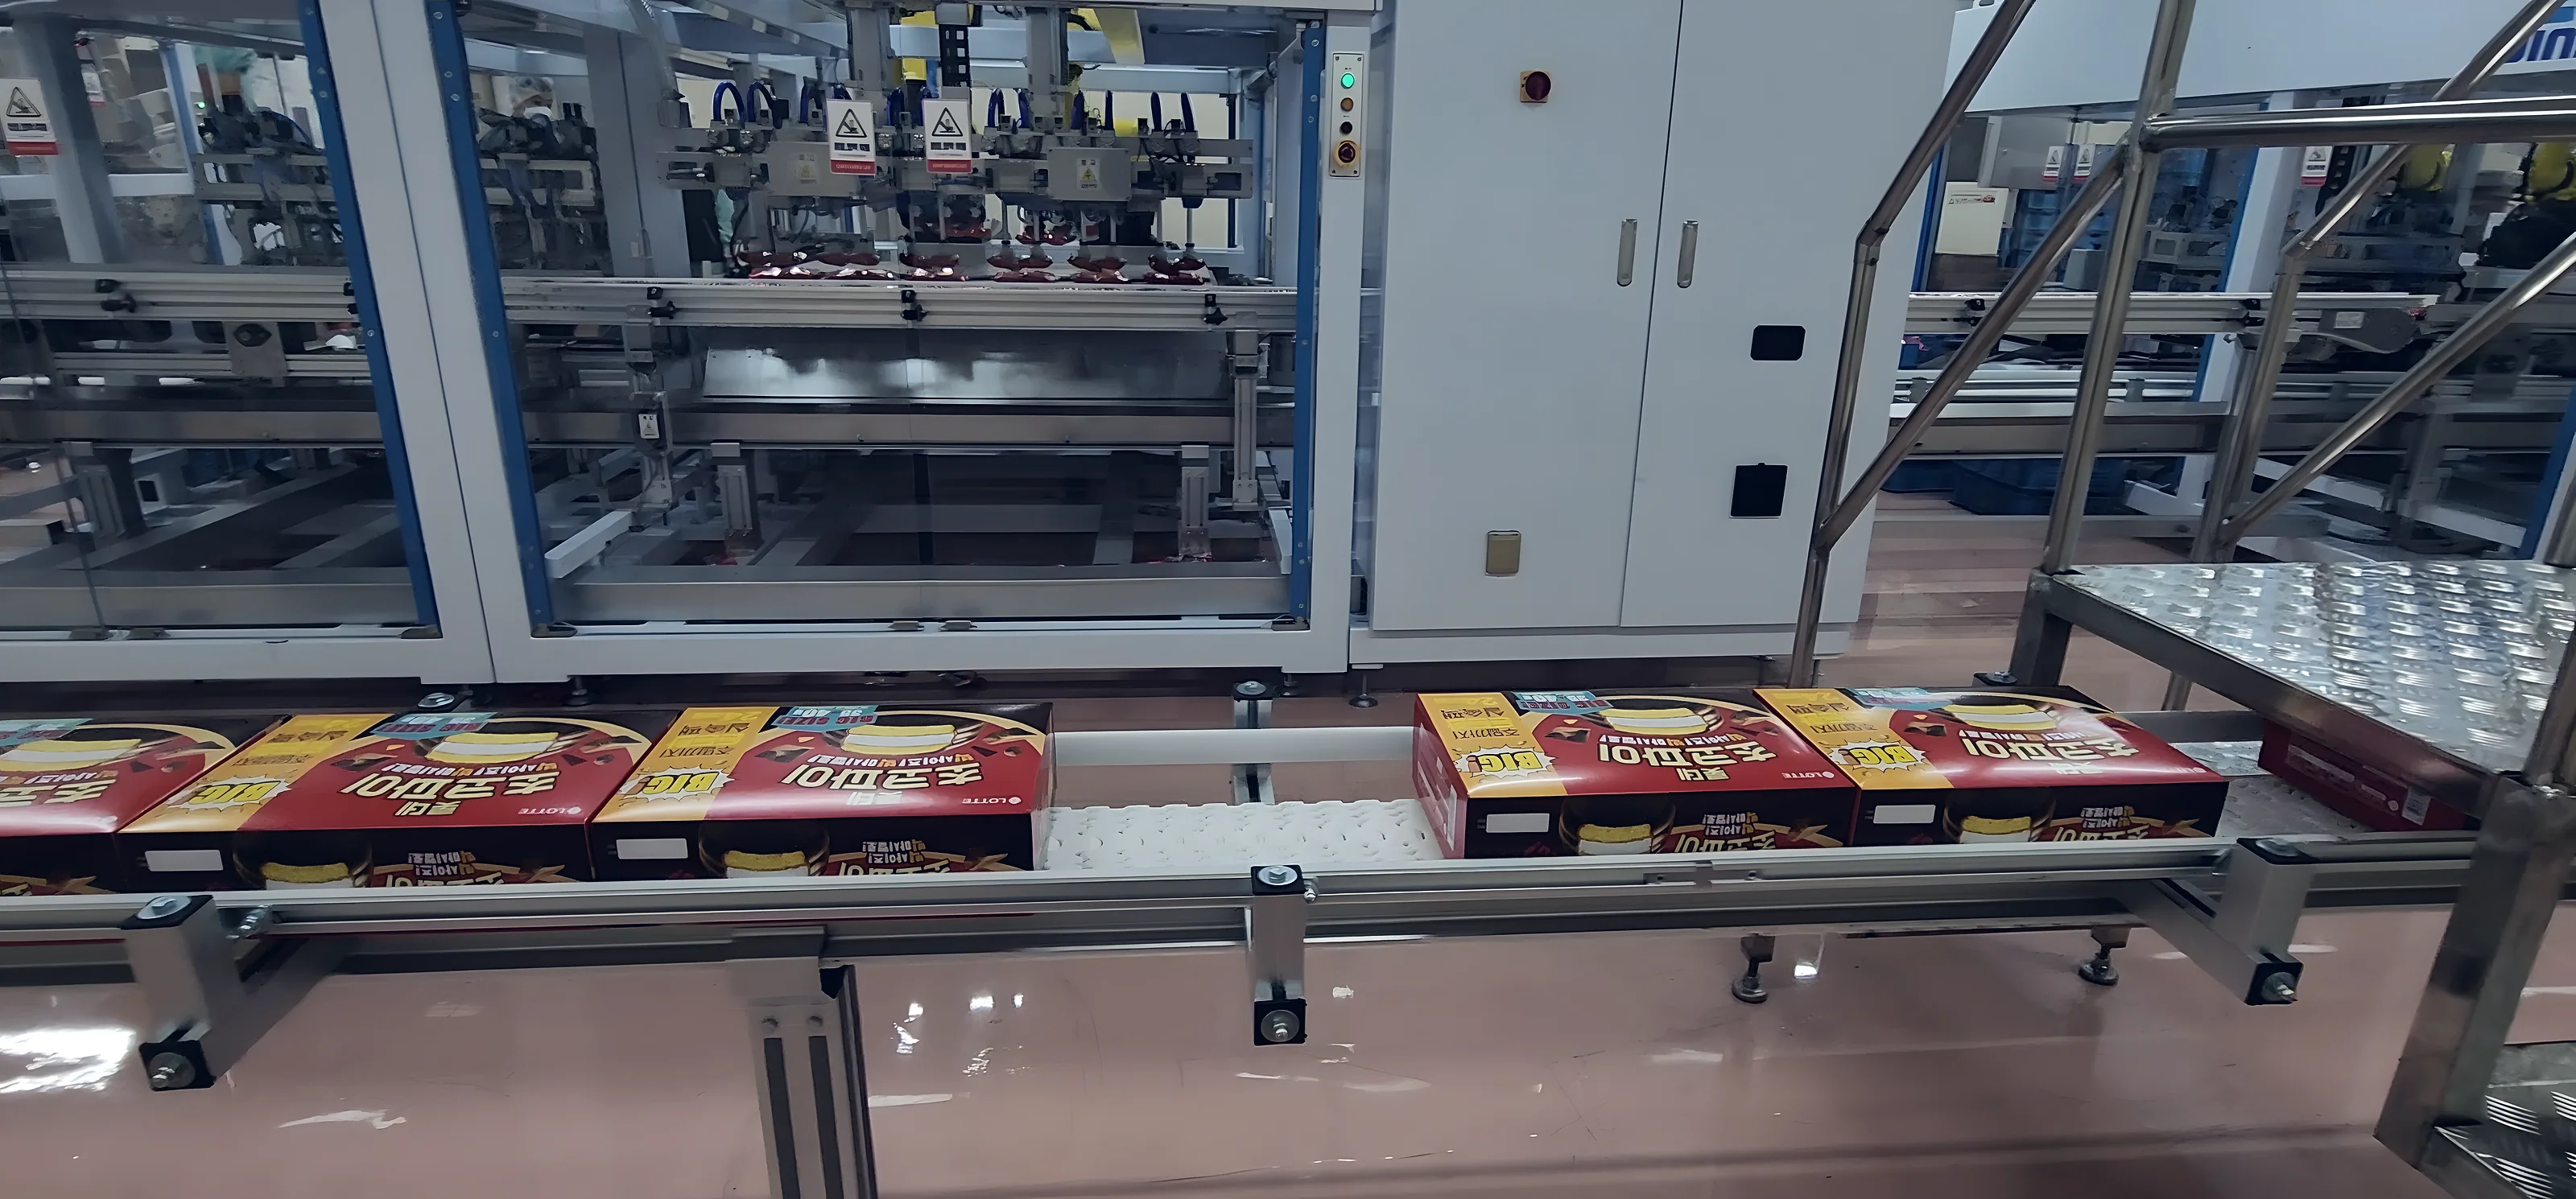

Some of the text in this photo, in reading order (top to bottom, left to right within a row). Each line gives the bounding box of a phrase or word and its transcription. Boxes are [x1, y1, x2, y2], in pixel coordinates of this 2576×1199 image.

[1598, 741, 1777, 767] 초코파이
[1838, 744, 1919, 765] BIG!
[1961, 738, 2140, 760] 초코파이
[1466, 751, 1542, 773] BIG!
[625, 772, 720, 795] BIG!
[779, 762, 982, 790] 초코파이
[1676, 766, 1730, 781] 롯데
[336, 770, 560, 800] 초코파이
[394, 801, 461, 816] 롯데
